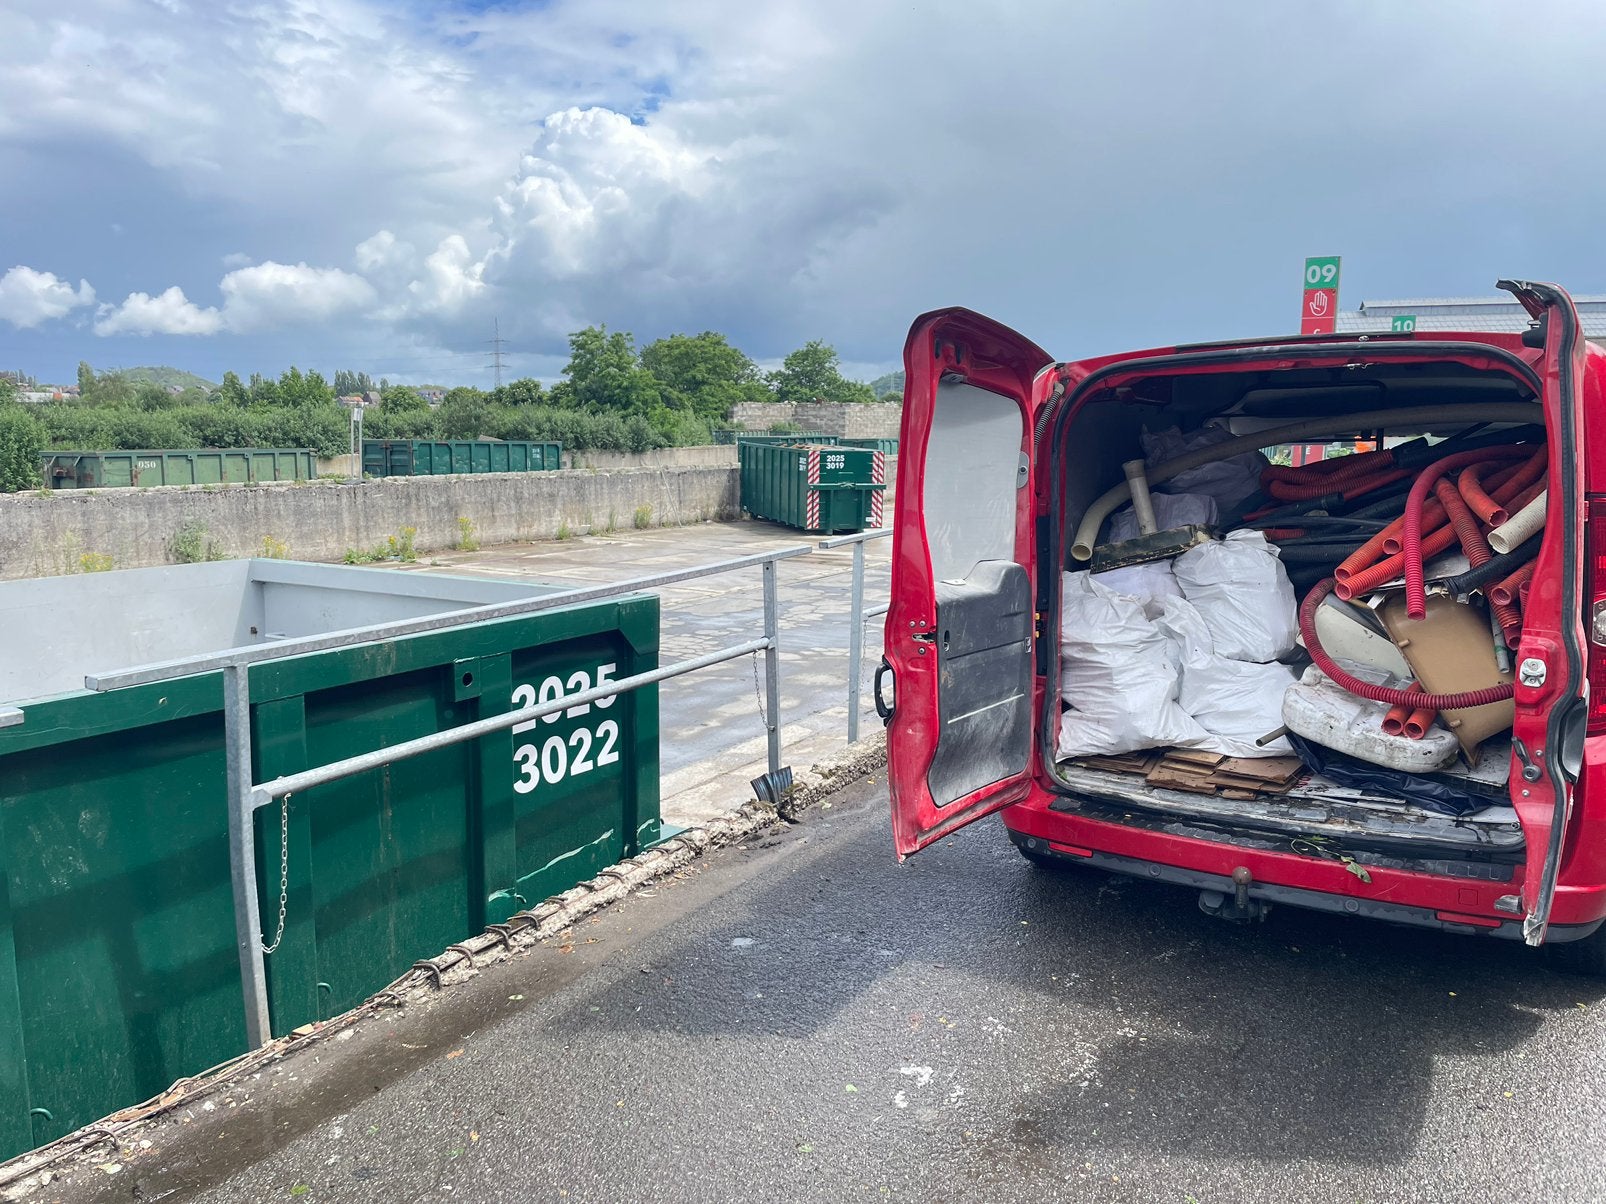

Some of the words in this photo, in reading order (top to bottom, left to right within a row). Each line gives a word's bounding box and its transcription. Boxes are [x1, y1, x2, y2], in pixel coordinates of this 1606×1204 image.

[1306, 264, 1337, 284] 09
[1394, 320, 1414, 332] 10
[826, 454, 846, 462] 2025
[826, 462, 845, 470] 3019
[511, 662, 617, 735] 2025
[512, 719, 619, 794] 3022
